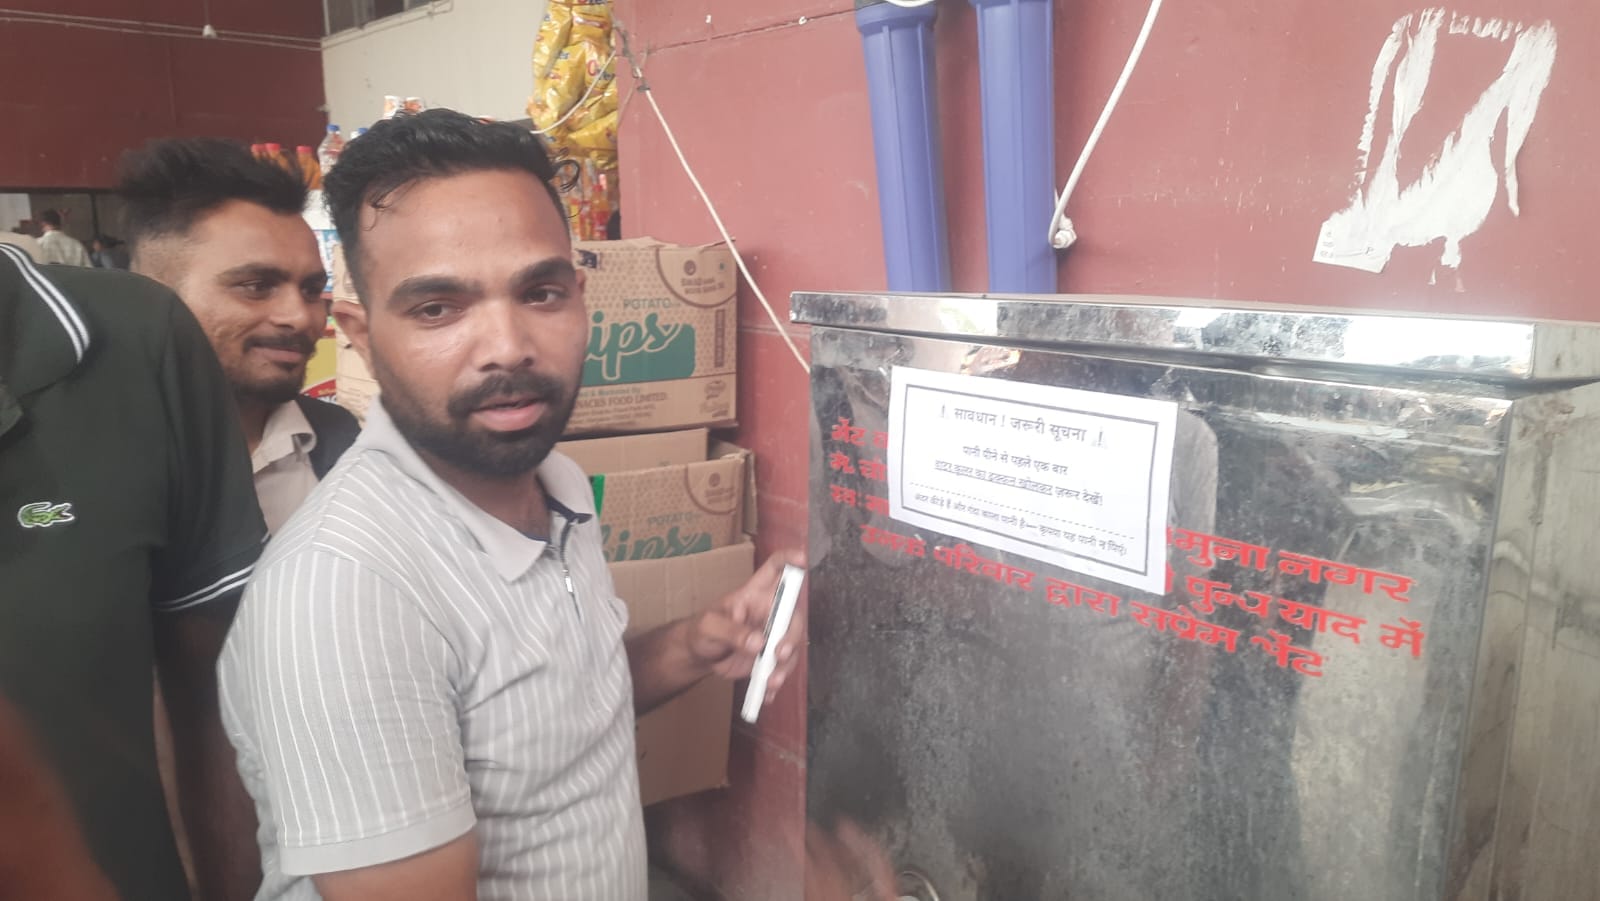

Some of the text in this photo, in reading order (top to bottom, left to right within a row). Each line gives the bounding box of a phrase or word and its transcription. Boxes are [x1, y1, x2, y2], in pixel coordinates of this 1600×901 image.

[623, 297, 672, 310] POTATO
[584, 309, 681, 381] ips
[608, 395, 634, 407] FOOD
[954, 407, 997, 426] सावधान
[1049, 423, 1087, 442] सूचना
[1166, 526, 1271, 571] मुना
[1278, 548, 1417, 603] नगर
[933, 543, 1037, 592] परिवार
[1045, 577, 1122, 618] द्वारा
[1250, 629, 1324, 678] भेंट
[1277, 597, 1368, 644] याद
[1379, 616, 1426, 659] में
